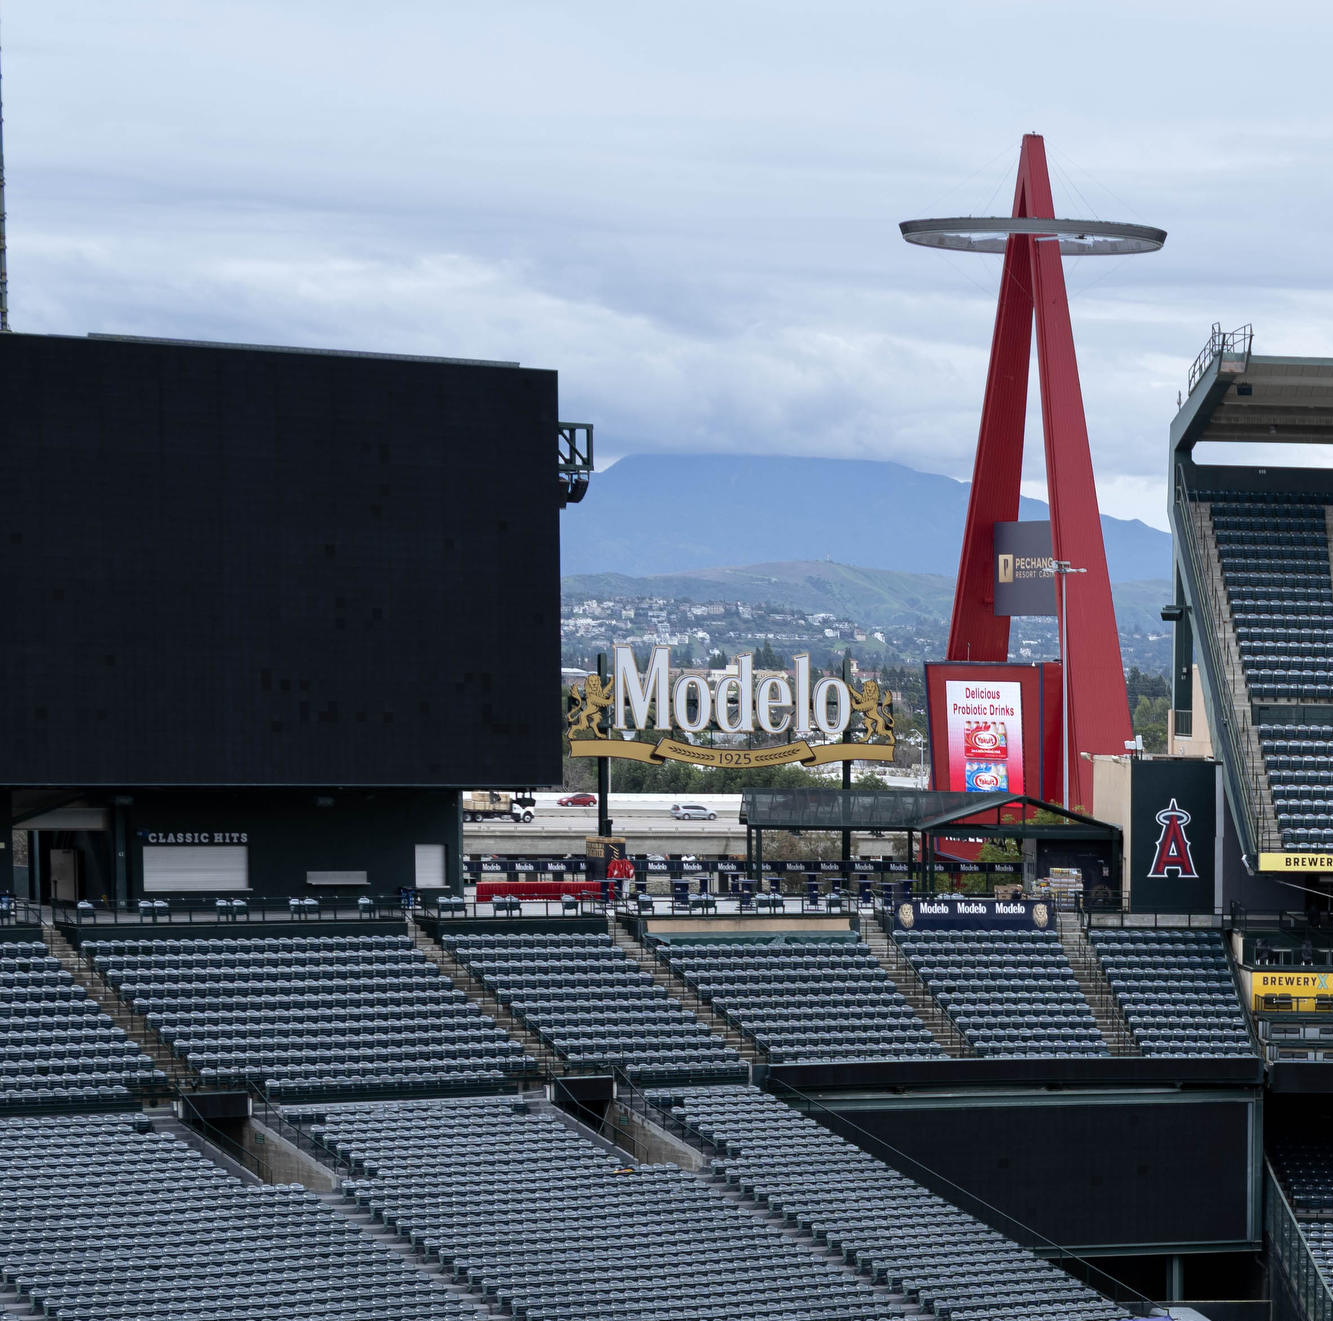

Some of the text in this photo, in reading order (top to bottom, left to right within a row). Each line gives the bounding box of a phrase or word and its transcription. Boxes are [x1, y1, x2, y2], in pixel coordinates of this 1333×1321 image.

[612, 643, 851, 734] Modelo
[965, 687, 1001, 700] Delicious
[953, 703, 1015, 717] Probiotic Drinks
[718, 752, 752, 765] 1925
[148, 832, 248, 843] CLASSIC HITS
[919, 902, 1026, 916] Modelo Modelo Modelo
